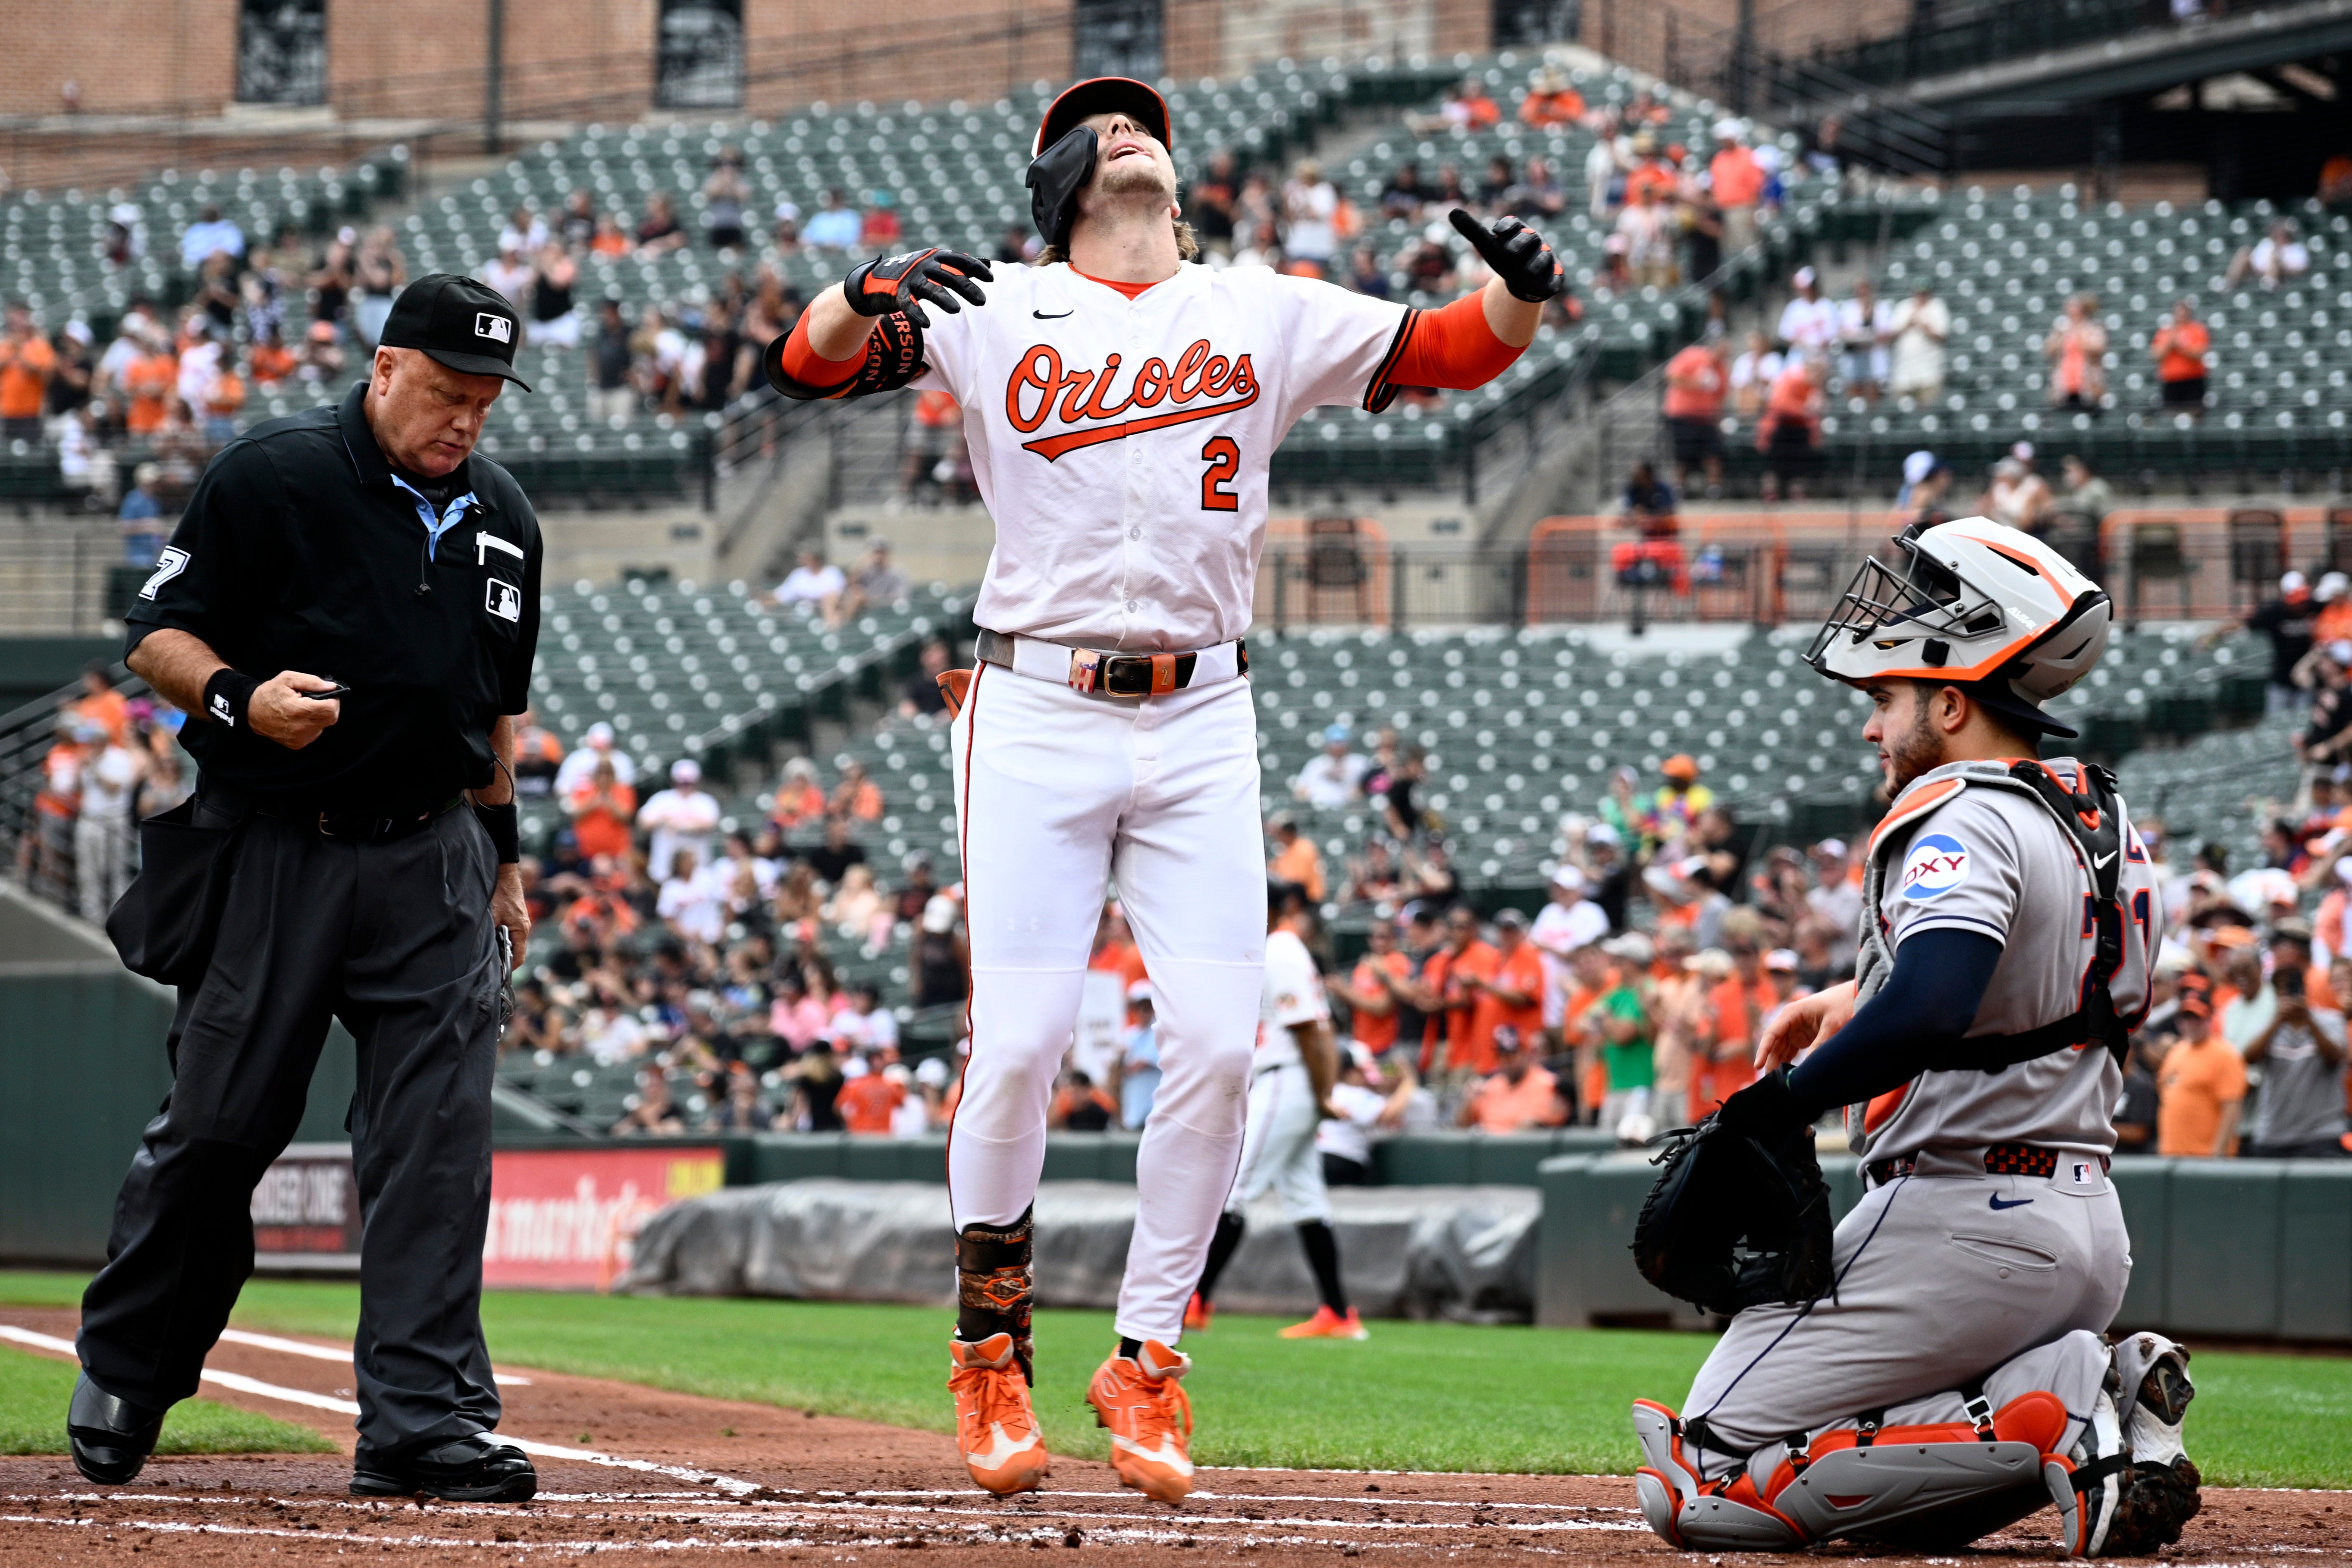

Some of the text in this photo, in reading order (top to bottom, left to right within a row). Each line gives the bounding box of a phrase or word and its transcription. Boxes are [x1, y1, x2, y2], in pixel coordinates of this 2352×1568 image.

[889, 310, 914, 373] ERSON
[1006, 339, 1260, 433] Orioles
[1201, 436, 1240, 512] 2
[138, 545, 191, 601] 7
[1160, 666, 1168, 687] 2
[1904, 856, 1966, 888] OXY
